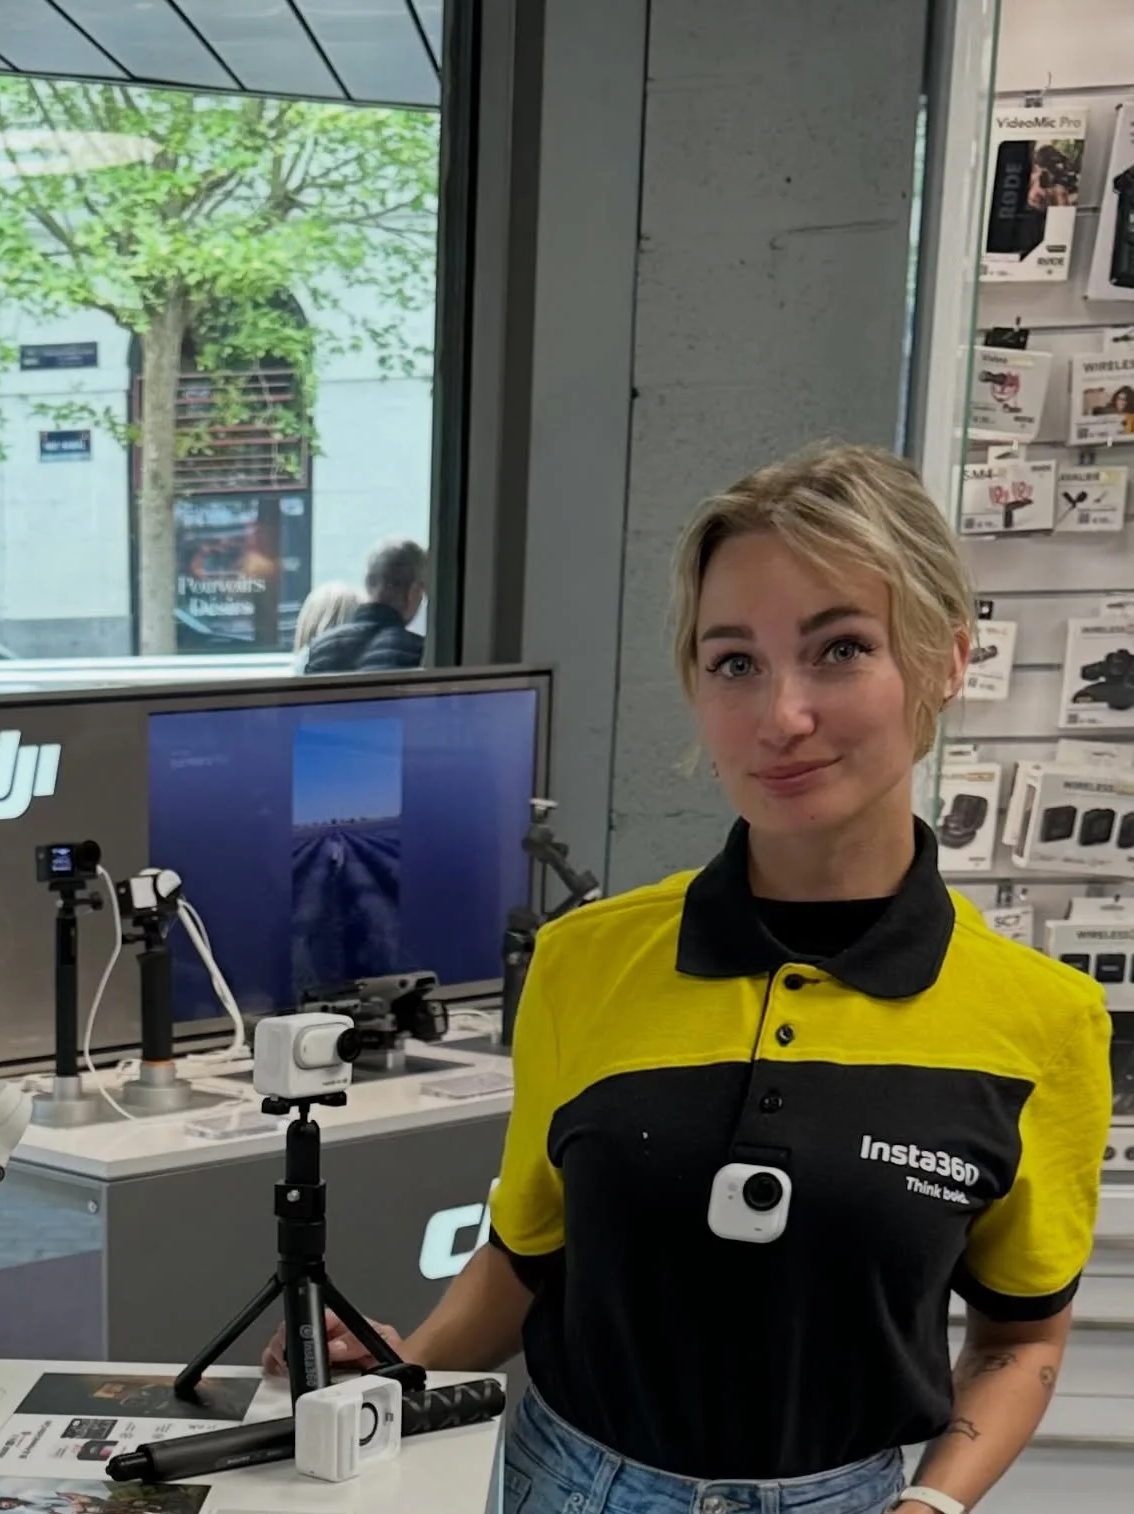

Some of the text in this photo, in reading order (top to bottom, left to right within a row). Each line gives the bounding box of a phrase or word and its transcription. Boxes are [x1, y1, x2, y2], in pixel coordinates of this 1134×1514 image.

[997, 116, 1081, 129] VideoMic Pro
[860, 1135, 980, 1187] Insta360
[906, 1176, 942, 1199] Think
